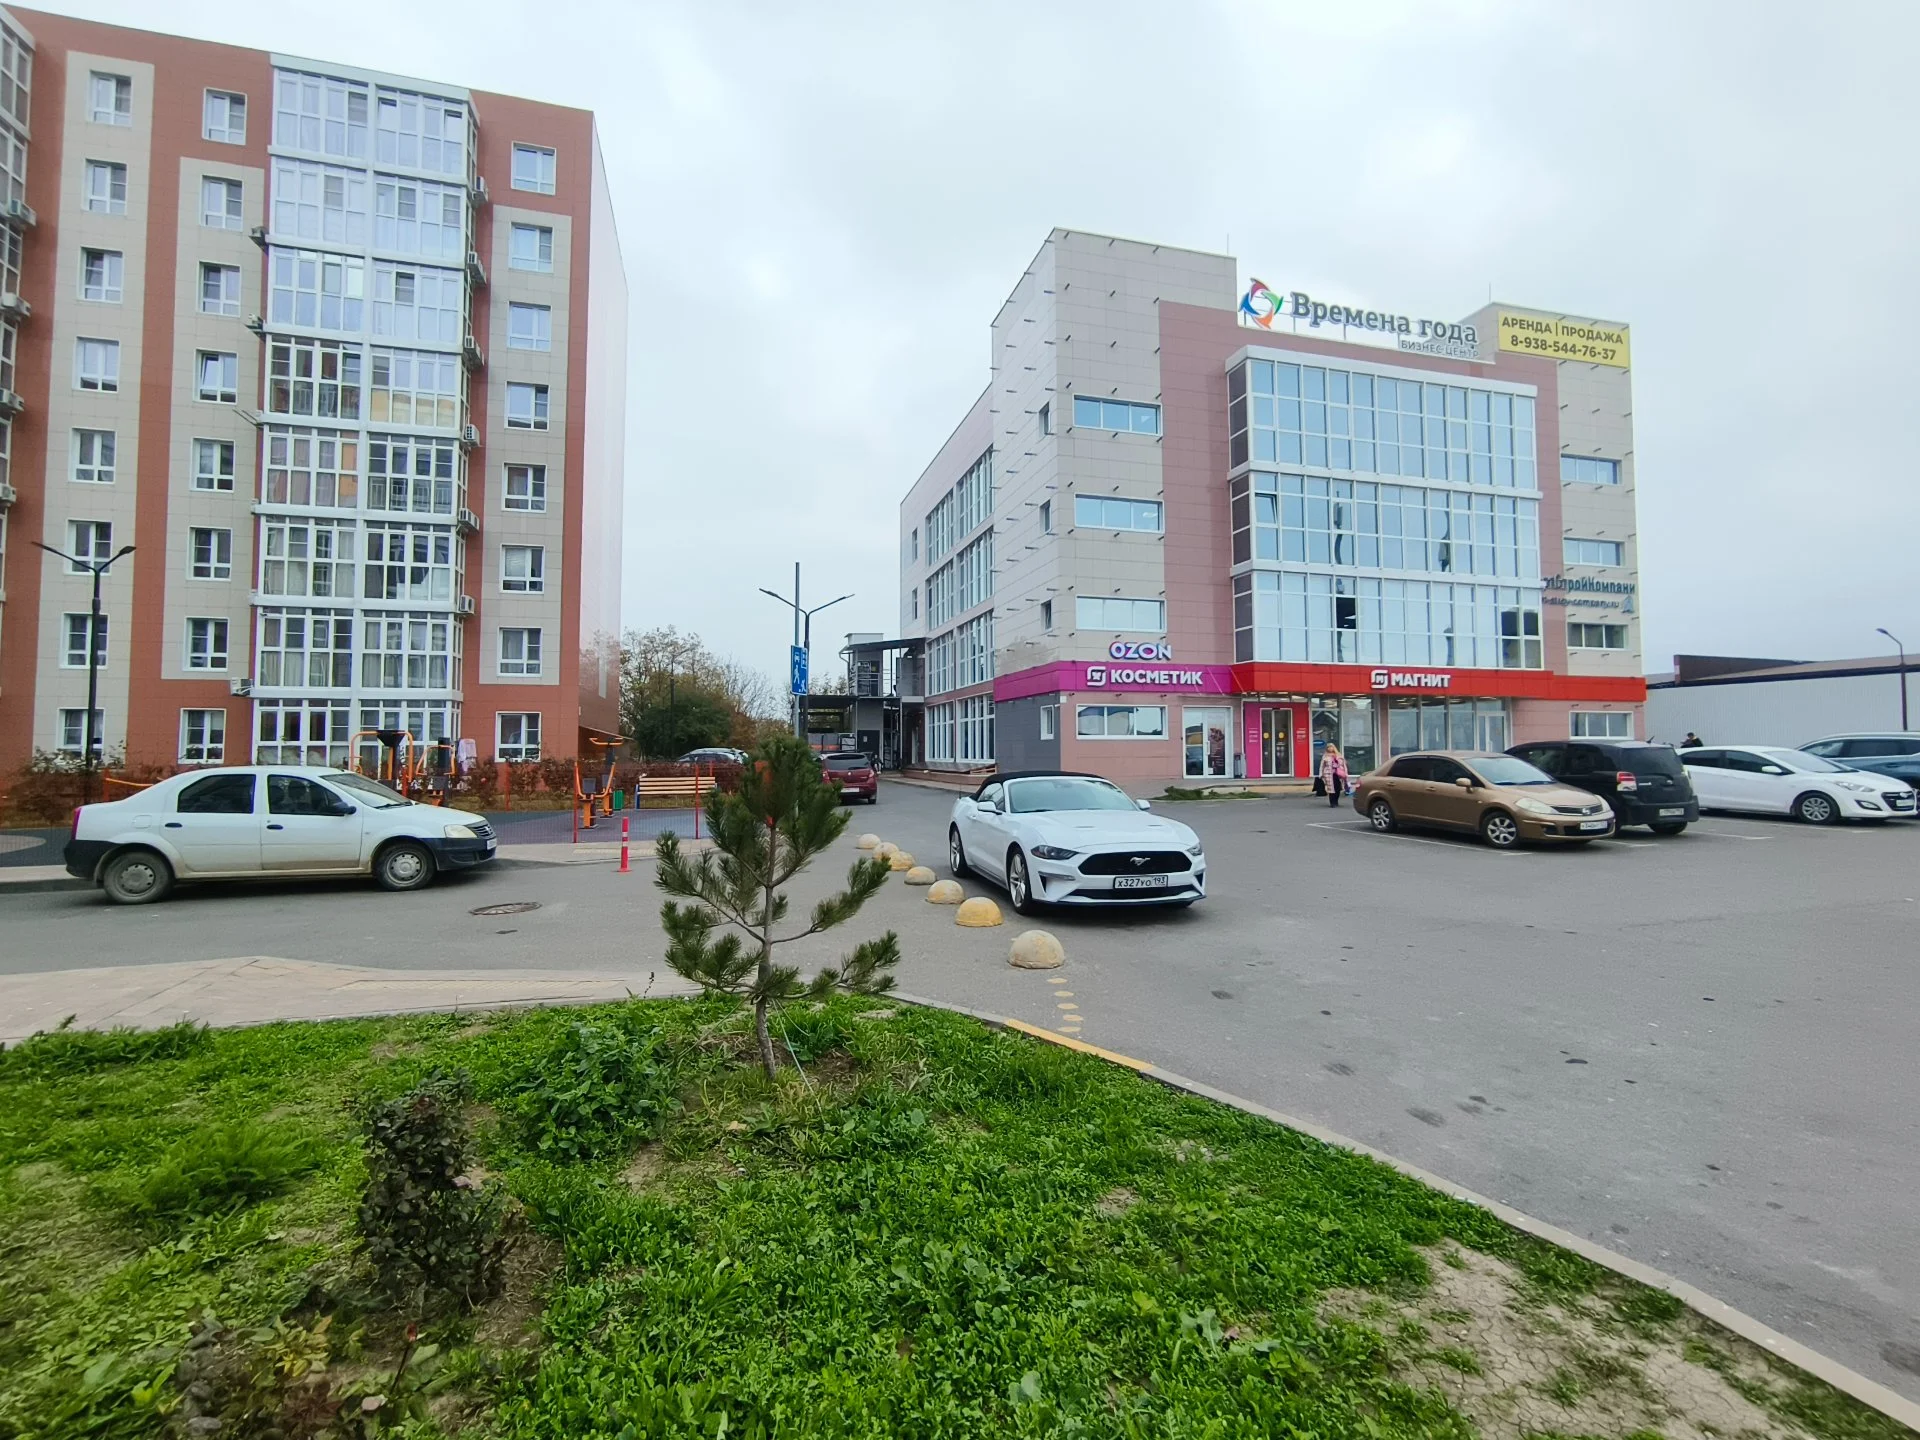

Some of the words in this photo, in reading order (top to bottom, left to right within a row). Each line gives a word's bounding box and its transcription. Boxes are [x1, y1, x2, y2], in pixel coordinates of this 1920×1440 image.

[1289, 291, 1412, 334] Времена
[1418, 318, 1478, 345] года
[1501, 316, 1552, 334] АРЕНДА
[1561, 325, 1624, 345] ПРОДАЖА
[1510, 334, 1617, 361] 8-938-544-76-37
[1109, 641, 1172, 660] OZON
[1110, 669, 1204, 685] КОСМЕТИК
[1390, 672, 1452, 688] МАГНИТ
